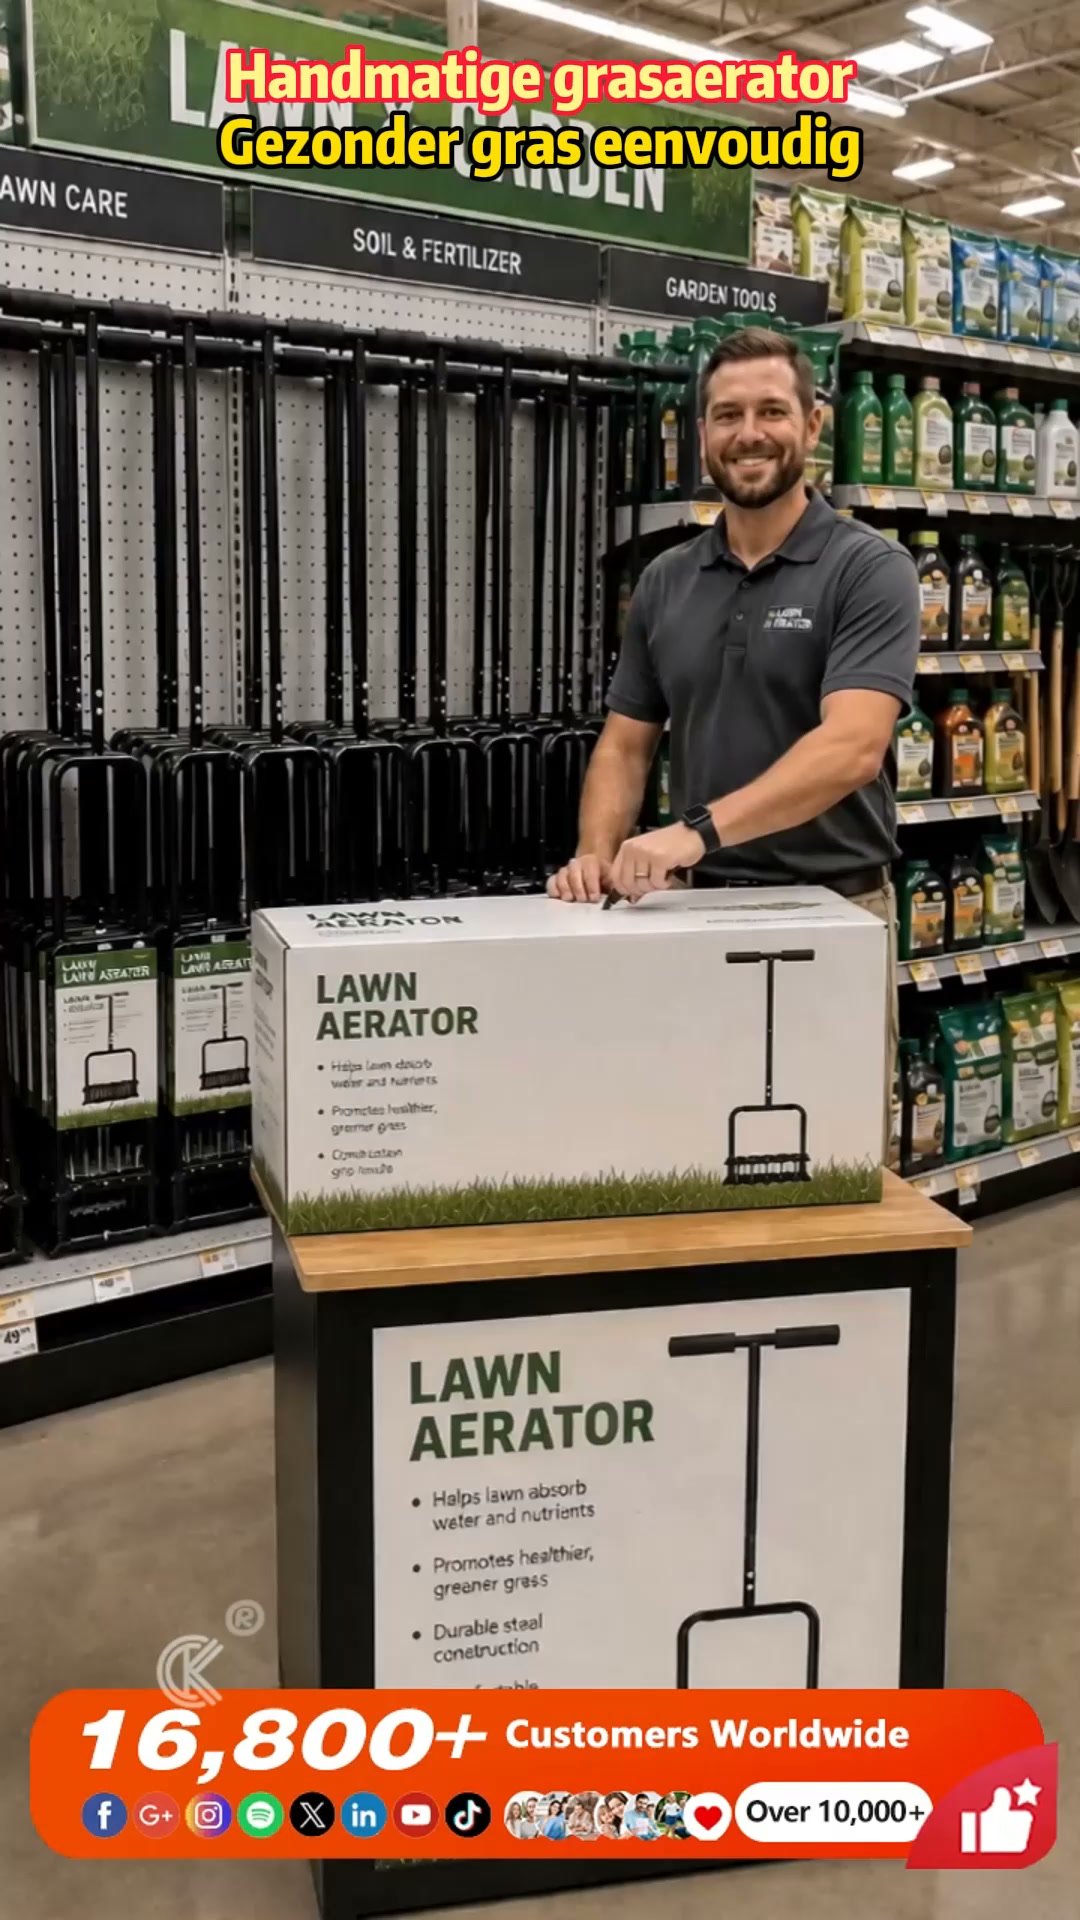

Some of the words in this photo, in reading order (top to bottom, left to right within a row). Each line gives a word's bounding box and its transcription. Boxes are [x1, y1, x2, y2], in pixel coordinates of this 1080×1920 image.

[0, 173, 56, 208] AWN
[65, 184, 128, 219] CARE
[353, 228, 397, 257] SOIL
[402, 236, 417, 260] &
[422, 239, 522, 275] FERTILIZER
[666, 277, 728, 305] GARDEN
[732, 287, 777, 312] TOOLS
[317, 972, 417, 1004] LAWN
[316, 1006, 478, 1040] AERATOR
[410, 1350, 560, 1405] LAWN
[409, 1399, 655, 1461] AERATOR
[486, 1486, 524, 1503] lawn
[528, 1479, 588, 1500] absorb
[486, 1507, 517, 1526] and
[433, 1553, 515, 1574] Promotes
[433, 1619, 499, 1641] Durable
